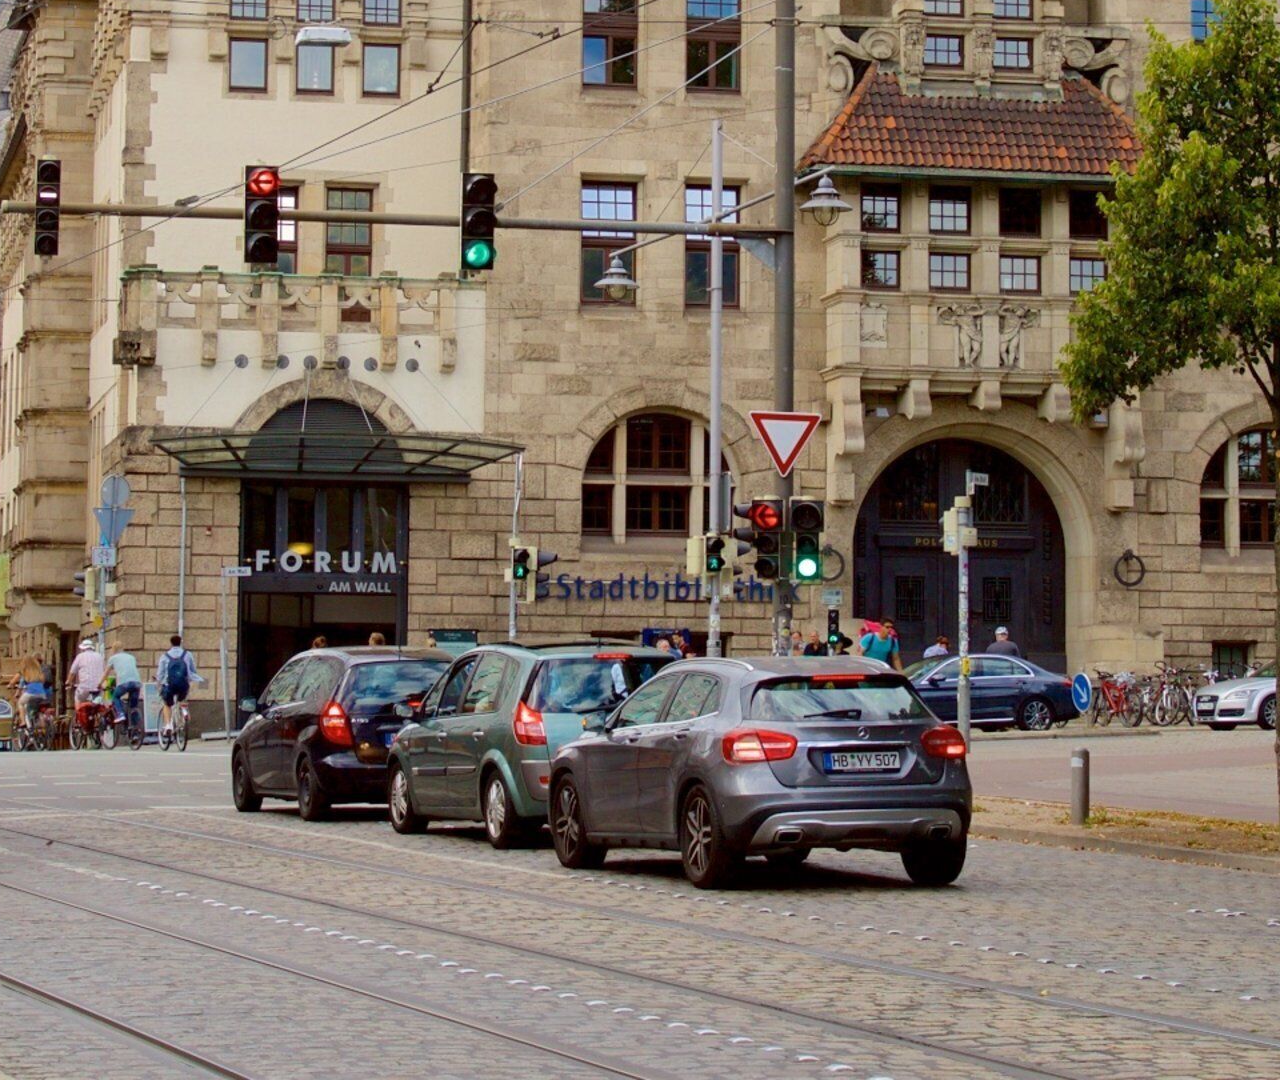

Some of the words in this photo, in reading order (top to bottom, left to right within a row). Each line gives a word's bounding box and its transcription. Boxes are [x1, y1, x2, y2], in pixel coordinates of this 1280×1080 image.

[255, 549, 398, 574] FORUM
[328, 581, 352, 594] AM
[354, 581, 392, 594] WALL
[831, 754, 849, 768] HB
[856, 753, 873, 767] YY
[874, 753, 898, 767] 507
